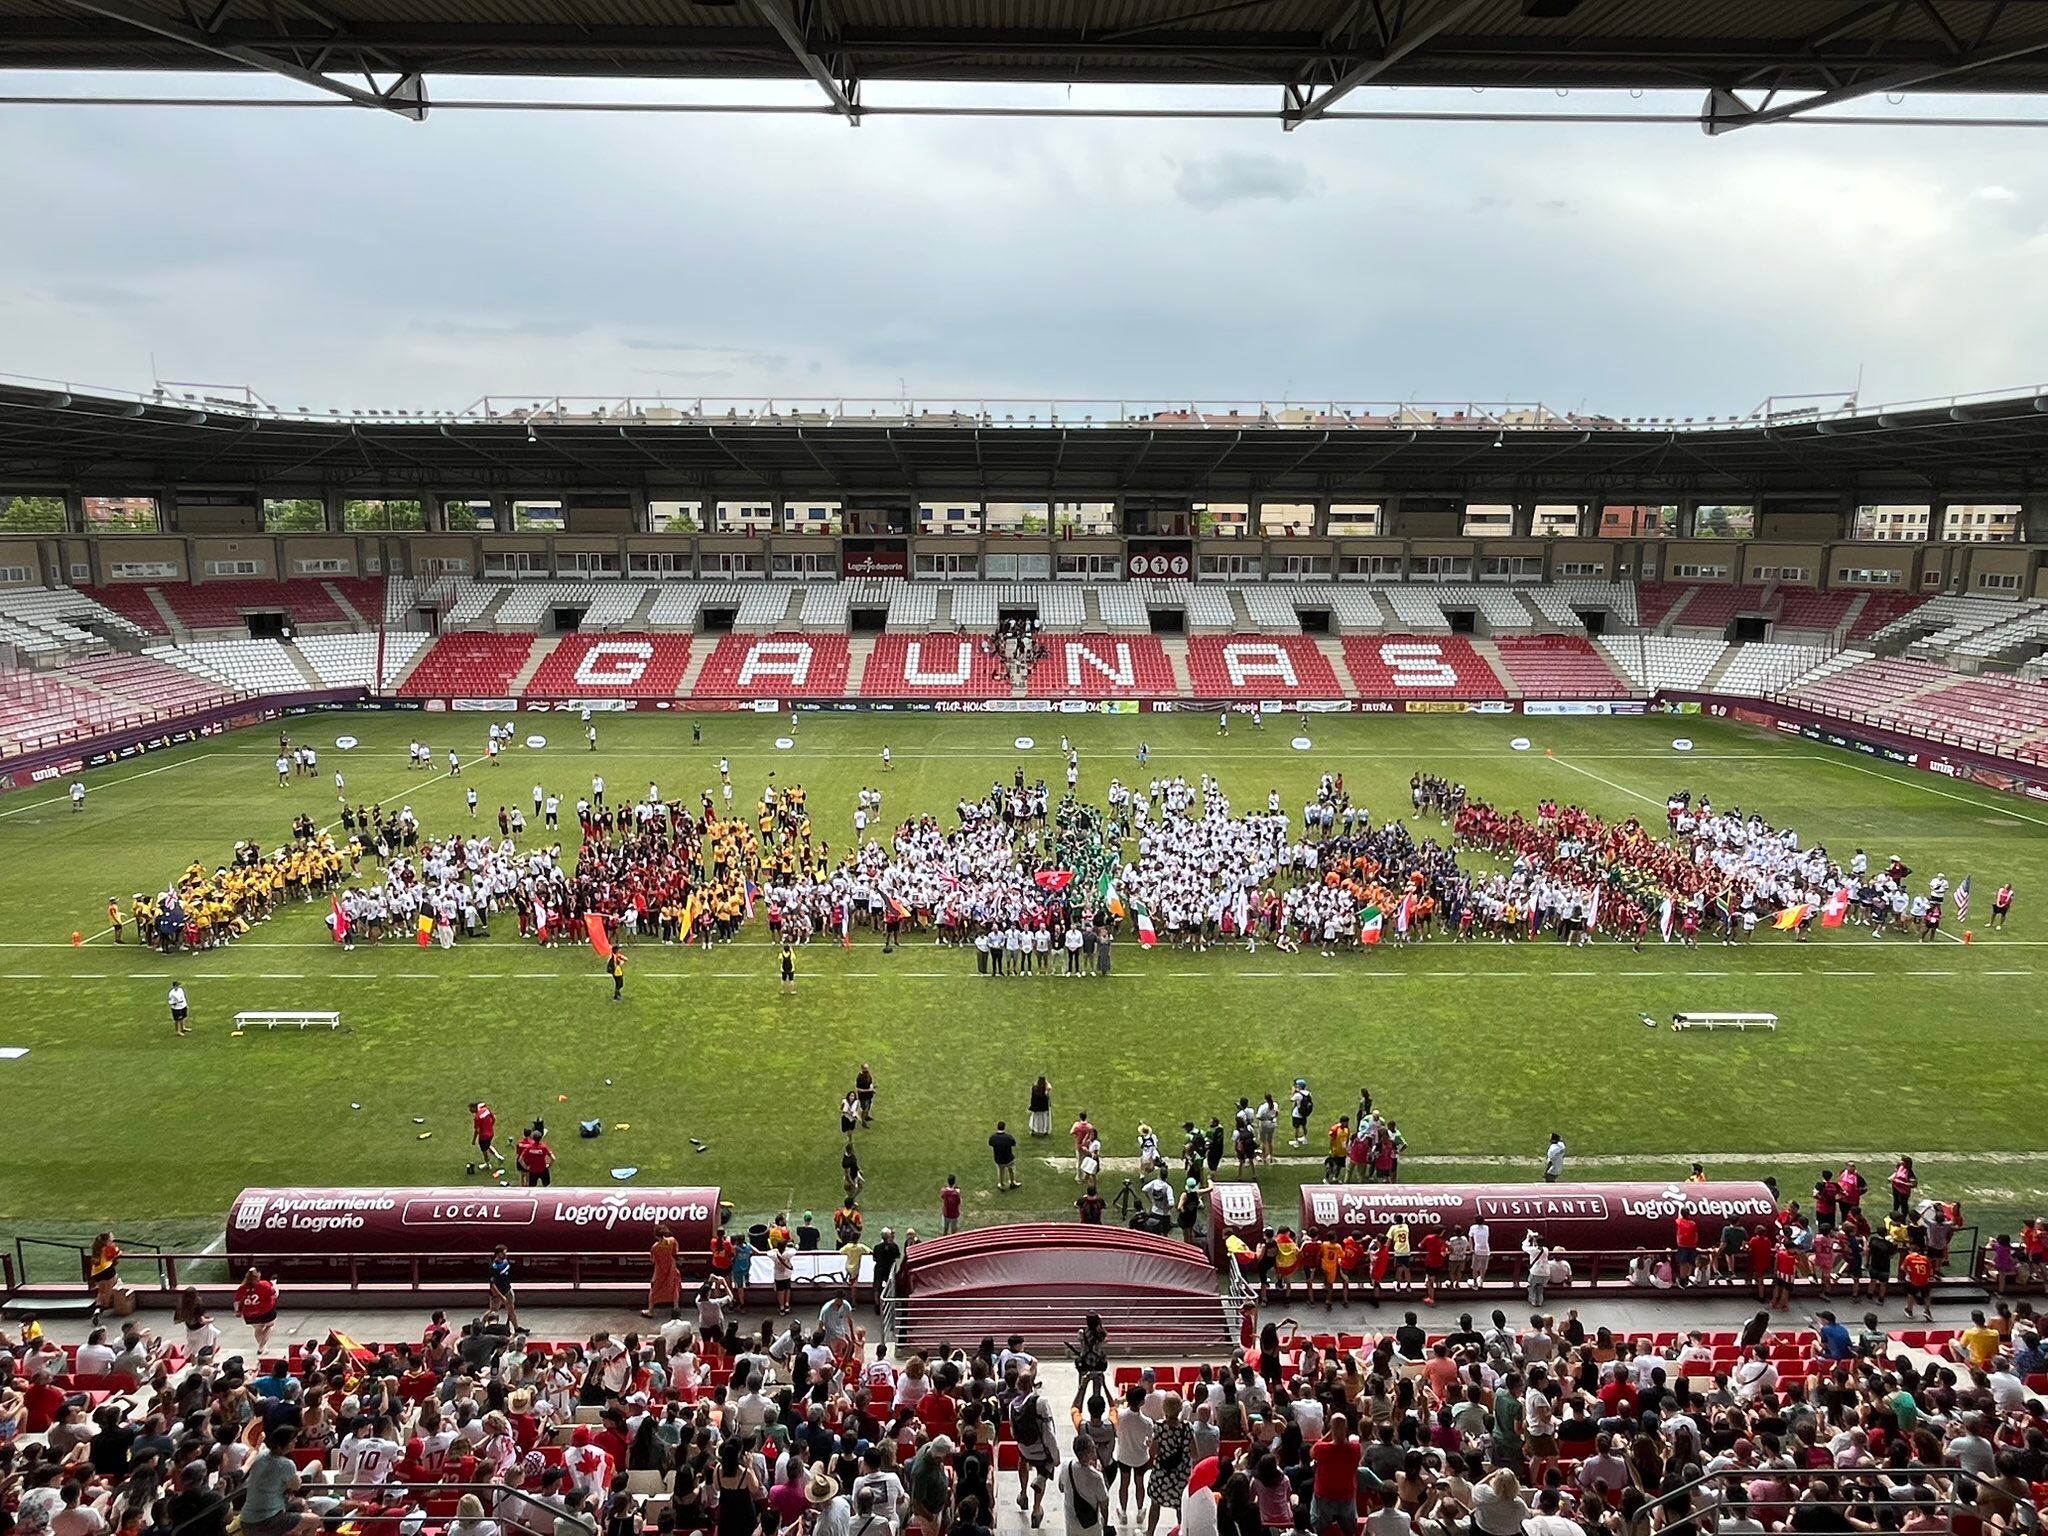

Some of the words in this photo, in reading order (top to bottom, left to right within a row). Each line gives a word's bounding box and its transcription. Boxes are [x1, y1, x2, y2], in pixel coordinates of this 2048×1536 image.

[1361, 701, 1394, 712] IRUÑA
[269, 1196, 396, 1214] Ayuntamiento
[1342, 1193, 1463, 1213] Ayuntamiento
[1485, 1200, 1601, 1216] VISITANTE
[432, 1205, 502, 1219] LOCAL
[1344, 1208, 1366, 1225] de
[265, 1213, 288, 1230] de
[291, 1213, 365, 1232] Logroño
[359, 1450, 382, 1471] 10
